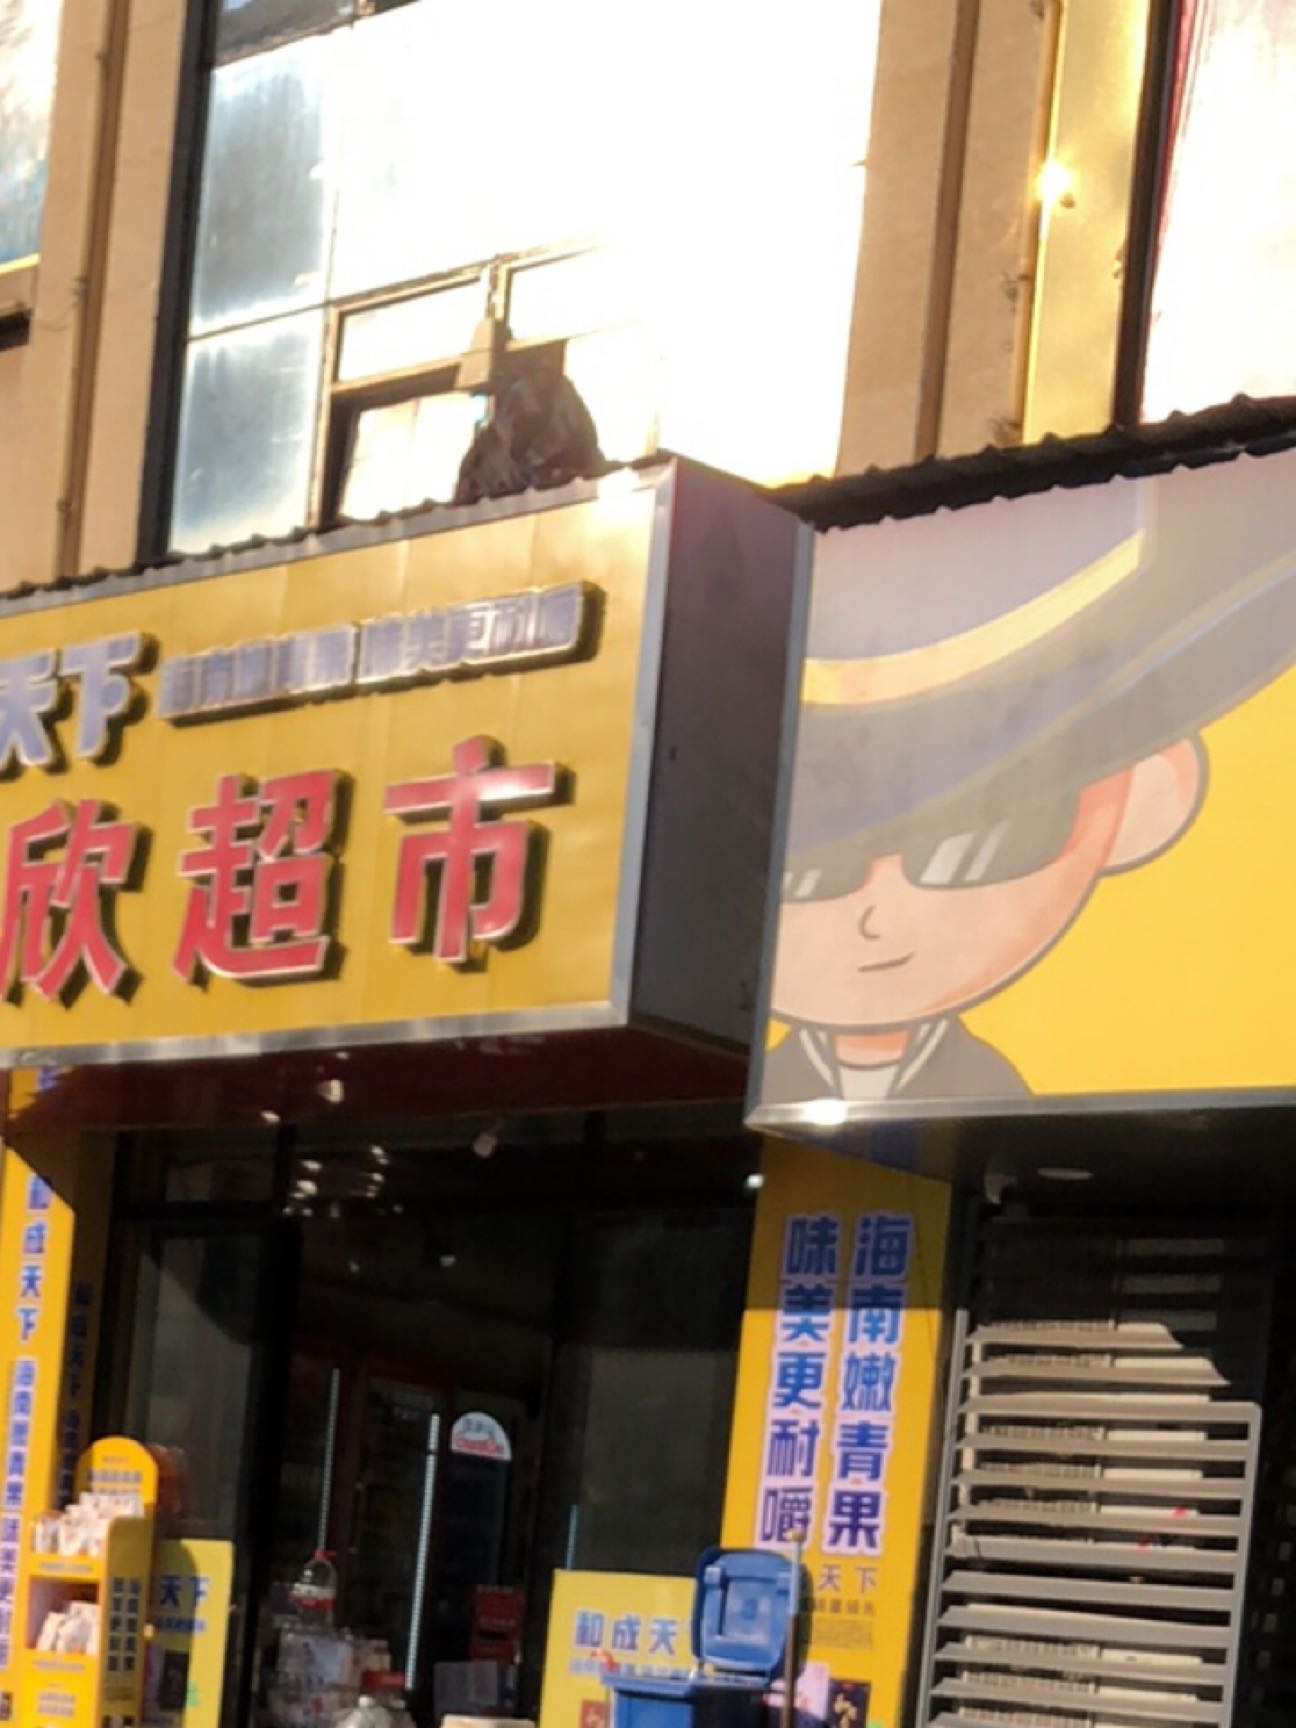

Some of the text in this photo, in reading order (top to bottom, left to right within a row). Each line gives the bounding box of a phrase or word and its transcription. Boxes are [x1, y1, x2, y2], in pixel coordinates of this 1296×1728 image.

[759, 1215, 839, 1547] 味美更耐嚼
[827, 1214, 912, 1551] 海南嫩青果
[574, 1608, 680, 1655] 和成天
